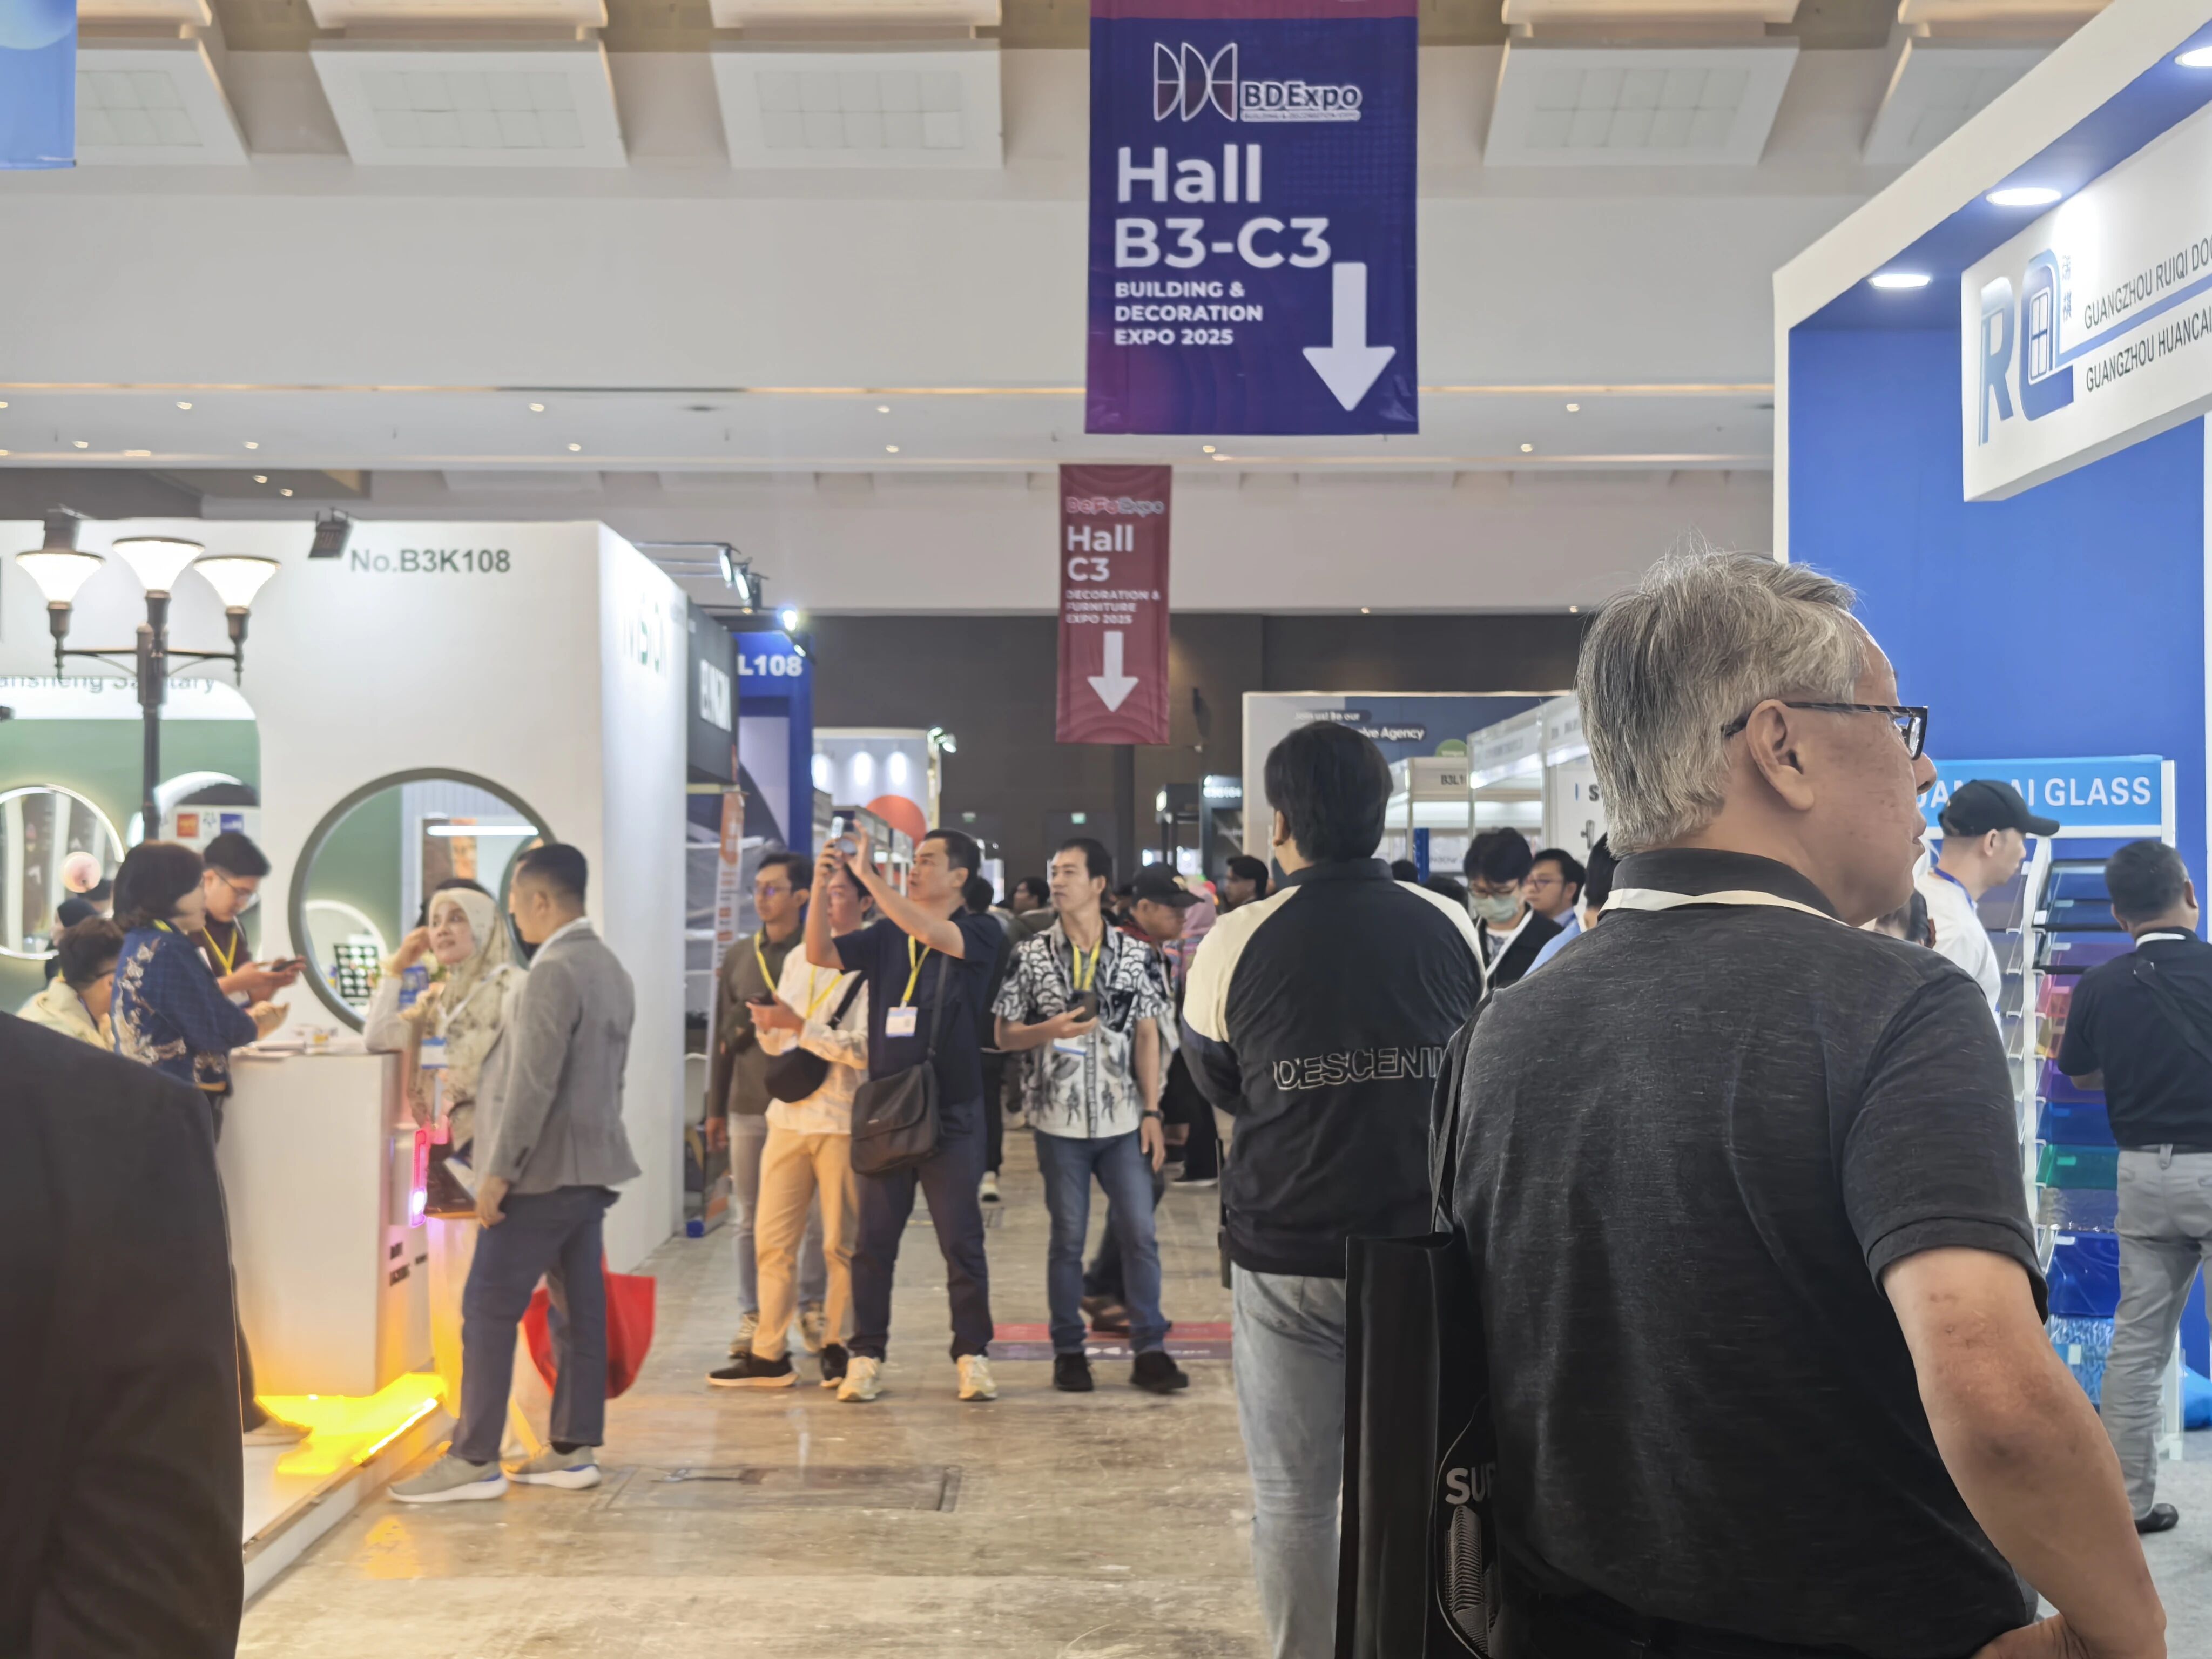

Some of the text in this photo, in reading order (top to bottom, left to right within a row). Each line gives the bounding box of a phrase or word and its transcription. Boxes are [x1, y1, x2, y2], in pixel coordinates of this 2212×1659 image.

[1243, 83, 1360, 110] BDExpo
[1118, 144, 1262, 203] Hall
[1115, 217, 1331, 268] B3-C3
[1115, 281, 1246, 298] BUILDING &
[2085, 268, 2152, 329] GUANGZHOU
[2155, 248, 2188, 291] RUIQI
[2191, 234, 2212, 272] DO
[1114, 305, 1264, 322] DECORATION
[1114, 328, 1234, 346] EXPO 2025
[2086, 334, 2155, 393] GUANGZHOU
[1067, 524, 1134, 552] Hall
[350, 548, 511, 573] No.B3K108
[1067, 557, 1110, 582] C3
[1065, 589, 1150, 600] DECORATION
[1065, 602, 1137, 612] FURNITURE
[1065, 613, 1100, 624] EXPO
[1381, 726, 1424, 740] Agency
[1440, 774, 1466, 786] B3L1
[2044, 777, 2152, 806] GLASS
